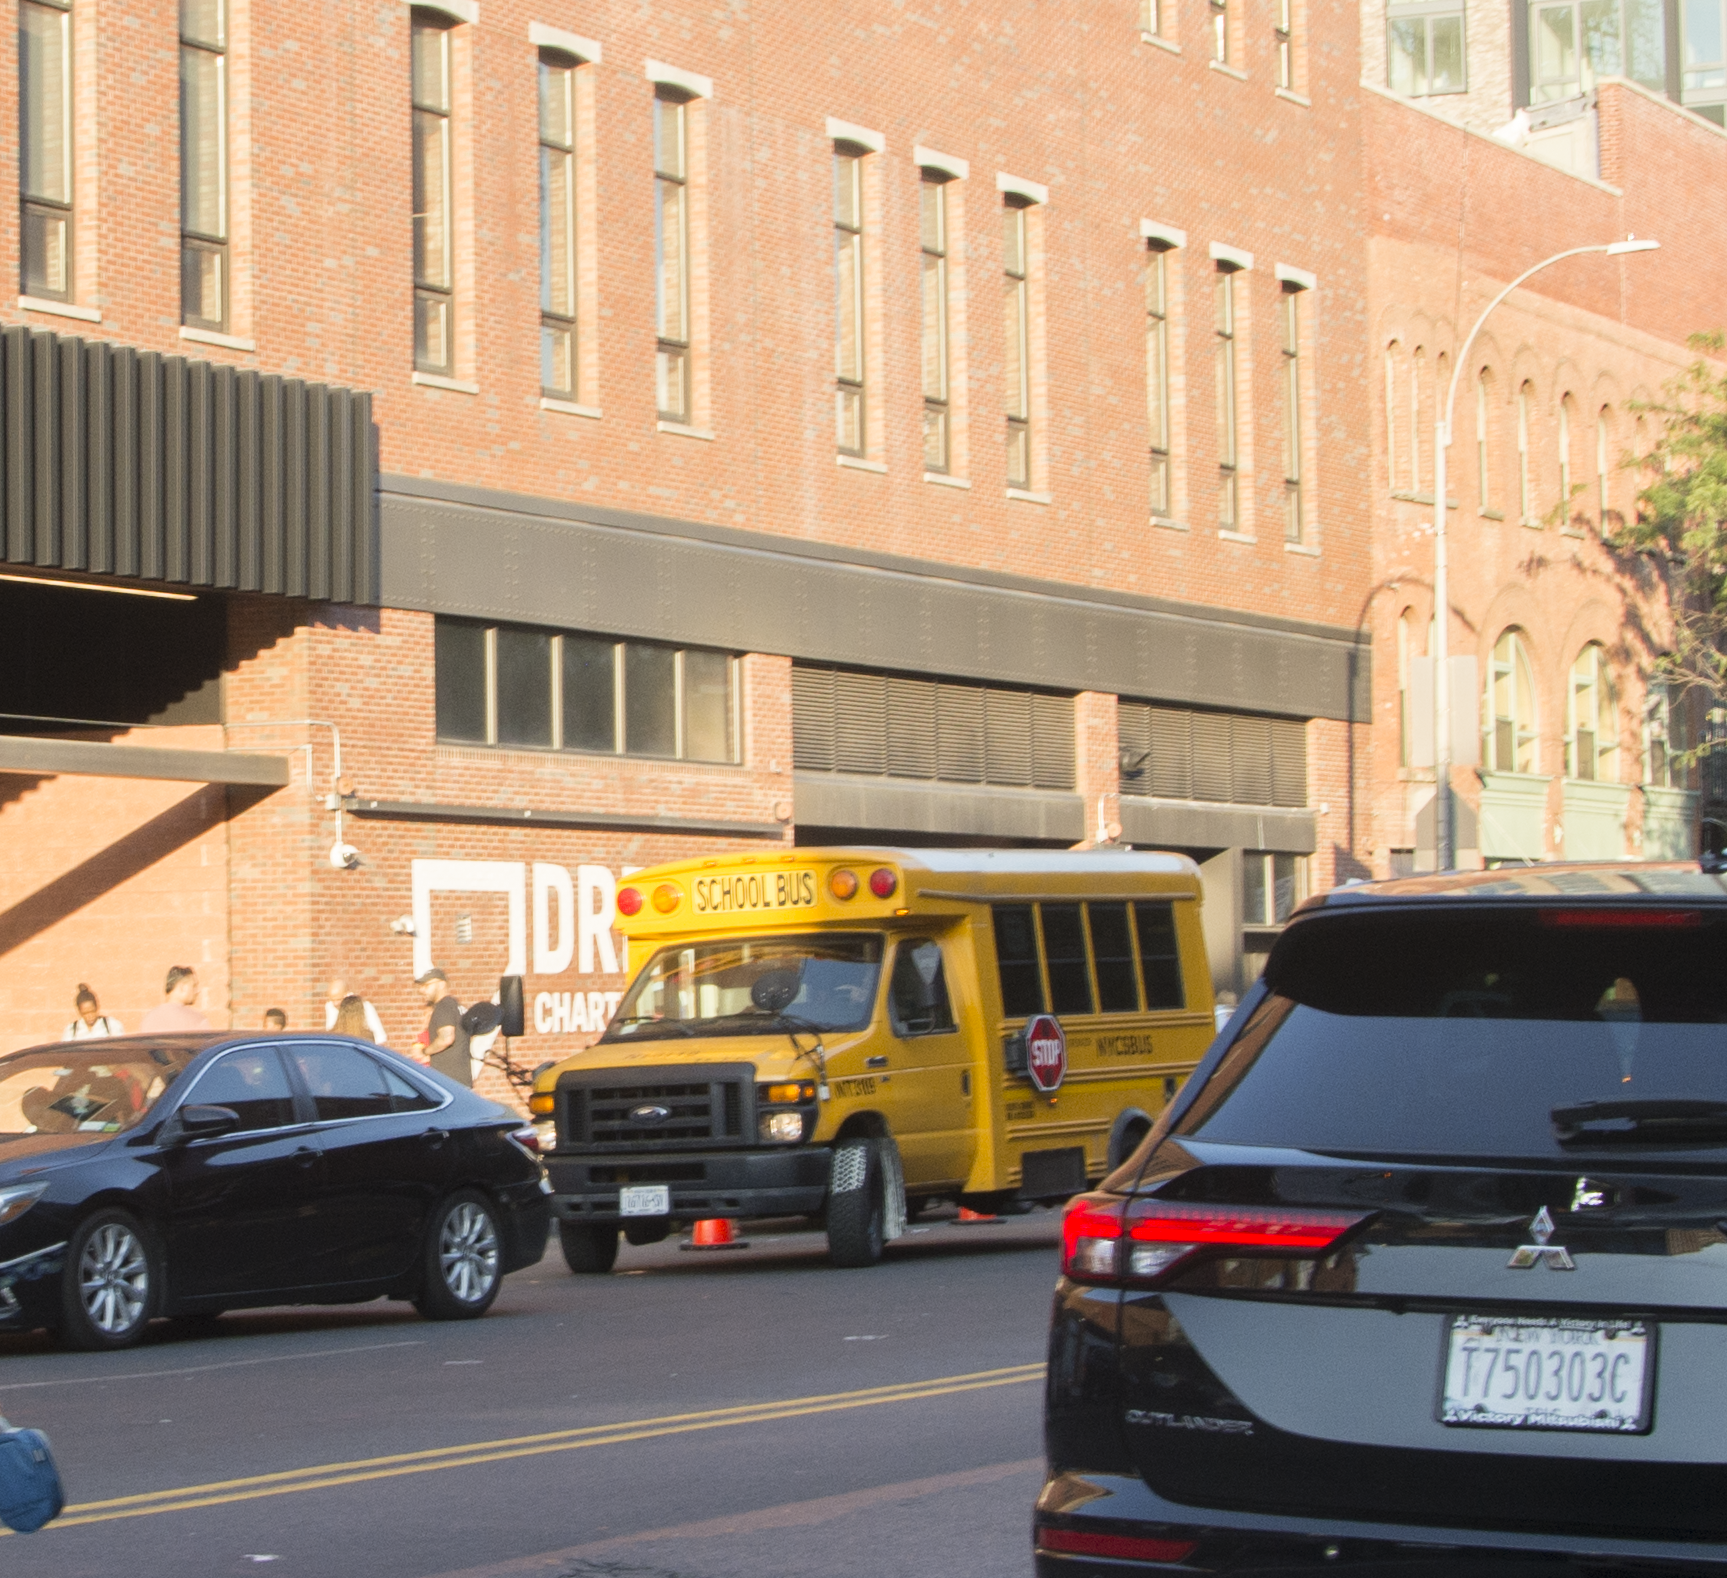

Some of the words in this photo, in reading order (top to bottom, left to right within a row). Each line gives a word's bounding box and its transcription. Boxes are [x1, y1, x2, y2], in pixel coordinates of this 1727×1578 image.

[697, 875, 771, 911] SCHOOL
[776, 872, 813, 906] BUS
[533, 863, 645, 974] DR
[534, 992, 624, 1034] CHART
[1032, 1039, 1061, 1067] STOP
[1495, 1325, 1540, 1343] NEW
[1549, 1328, 1600, 1346] YORK
[1461, 1346, 1630, 1403] T750303C
[1125, 1409, 1254, 1435] OUTLANDER
[1459, 1410, 1523, 1426] Victory
[1526, 1413, 1621, 1429] Mitsubishi
